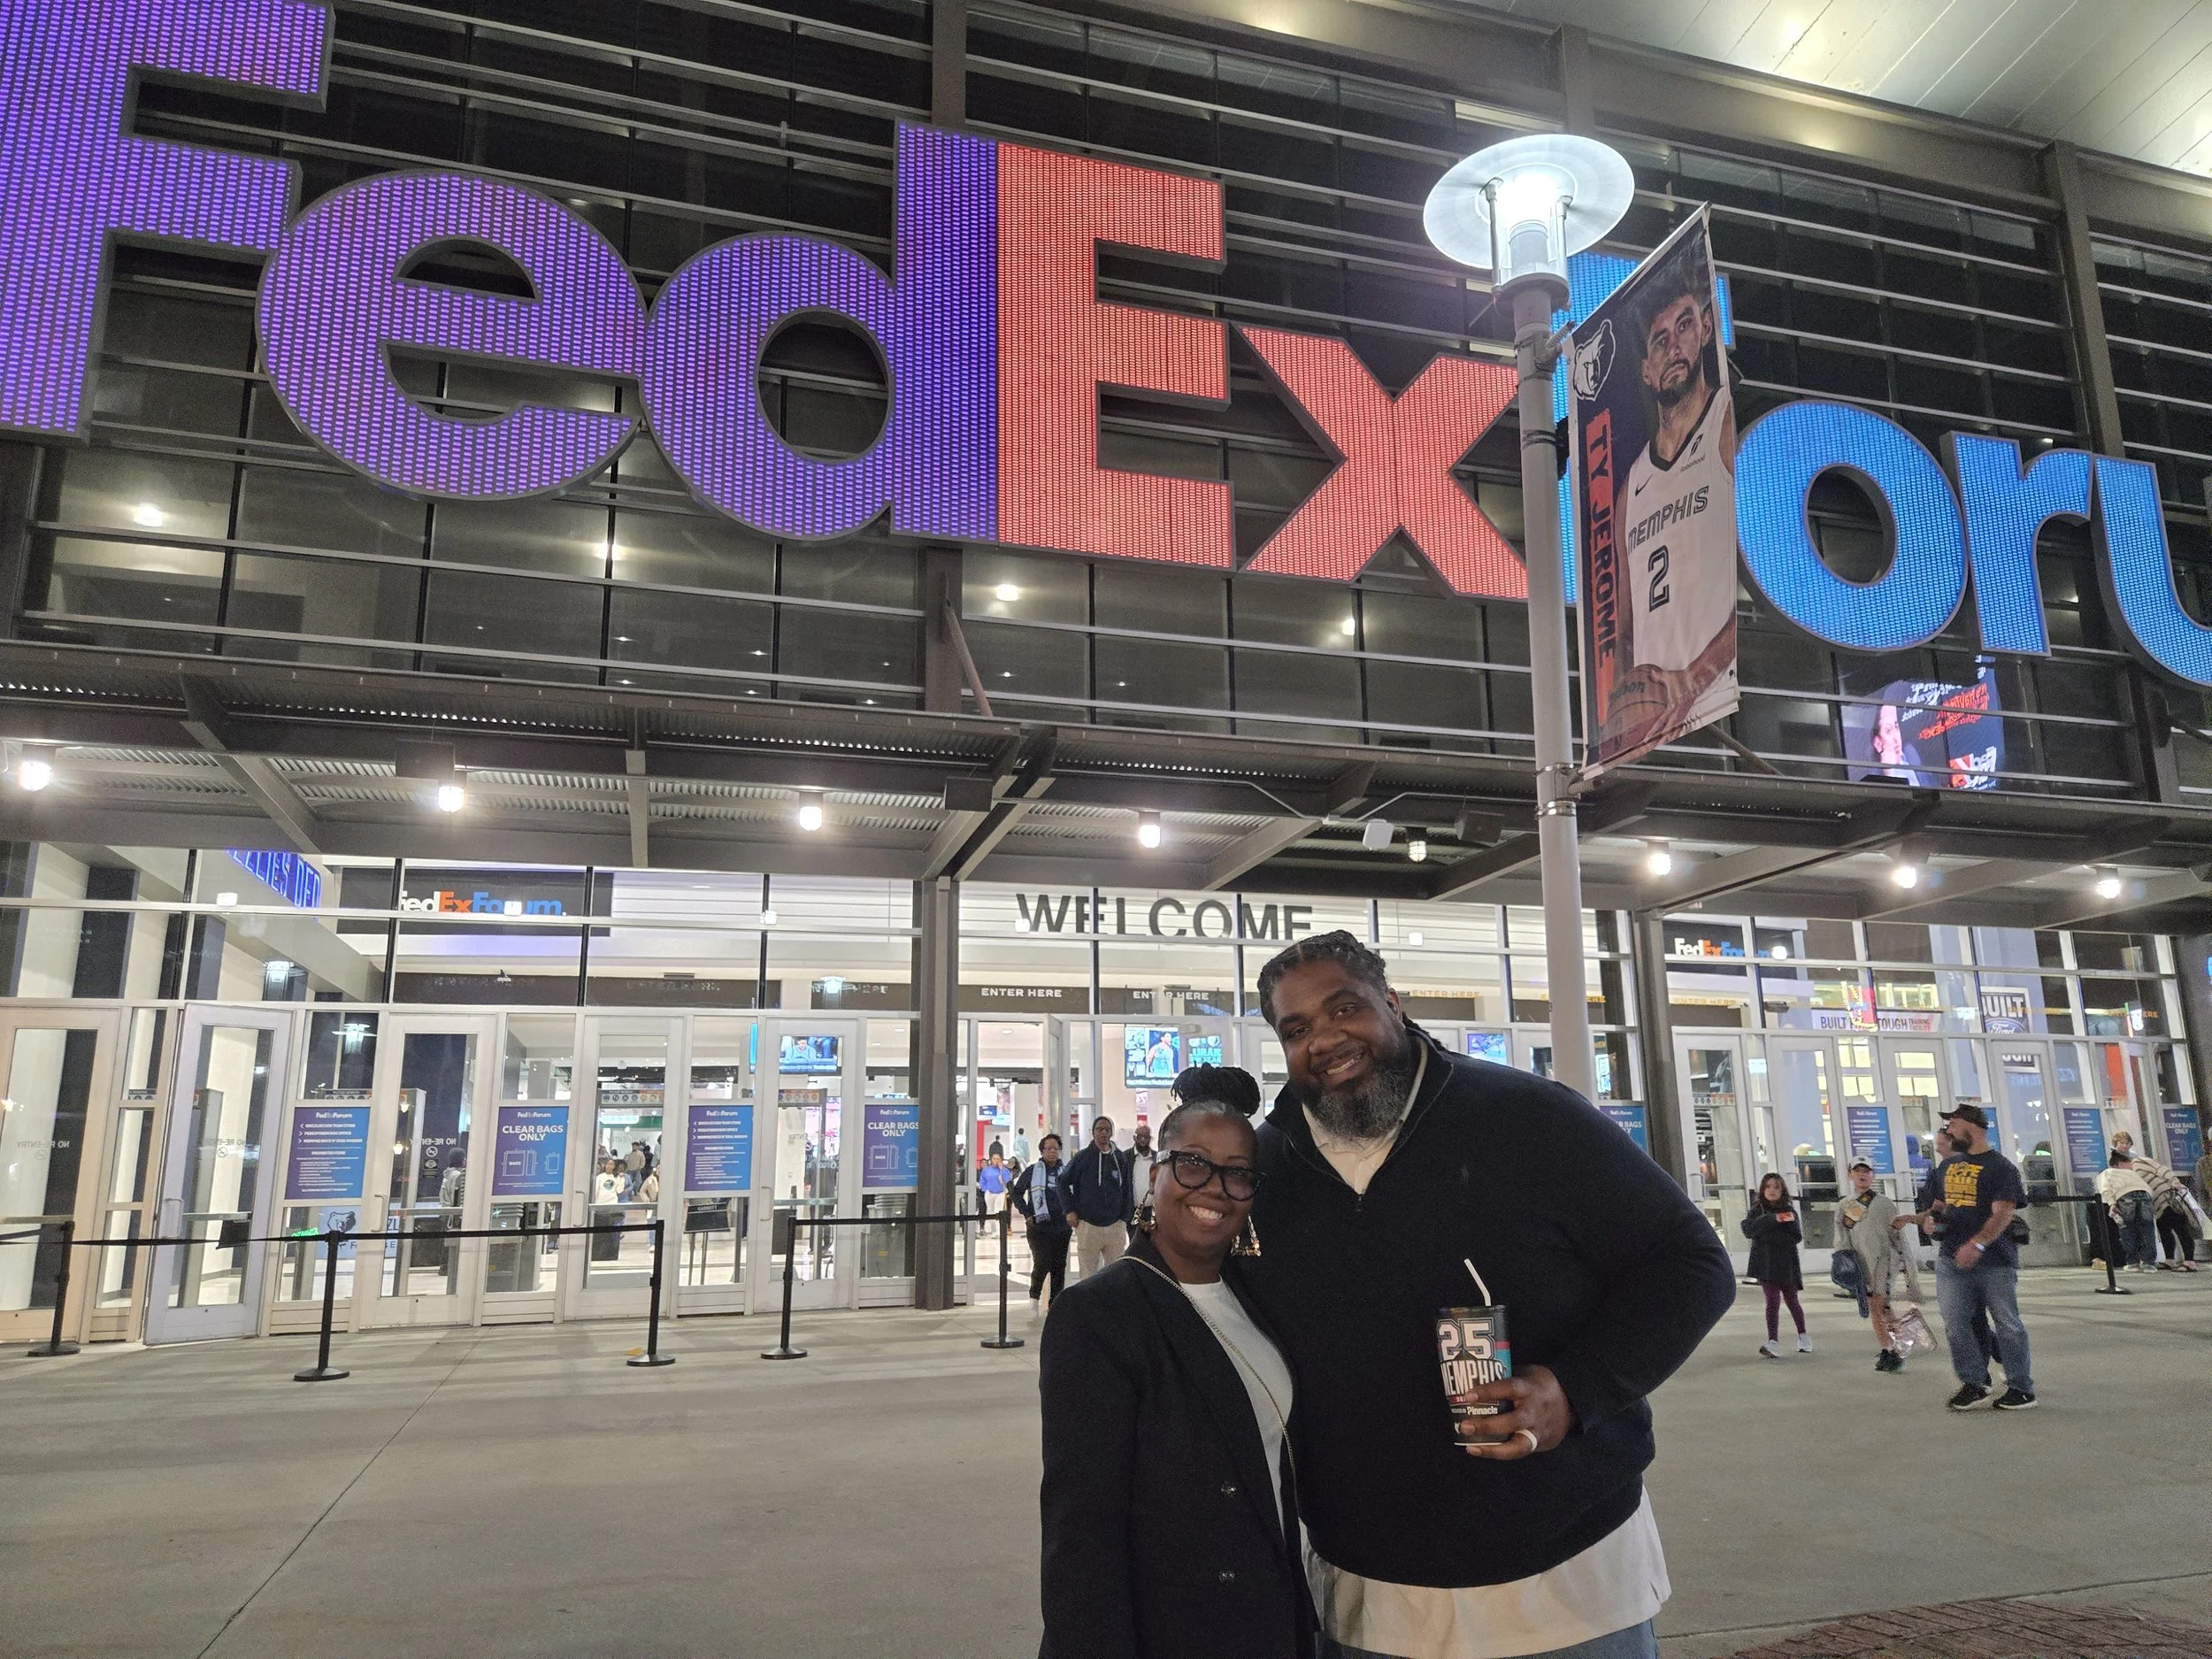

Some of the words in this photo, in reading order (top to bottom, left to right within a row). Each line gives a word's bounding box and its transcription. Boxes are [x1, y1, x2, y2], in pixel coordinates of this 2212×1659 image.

[1590, 425, 1609, 481] TY
[1628, 485, 1709, 556] MEMPHIS
[1592, 500, 1617, 669] JEROME
[1648, 545, 1670, 612] 2
[981, 988, 1025, 998] ENTER
[1027, 989, 1063, 998] HERE
[1133, 990, 1173, 1000] ENTR
[1177, 991, 1210, 1001] HERE
[1820, 1017, 1847, 1029] BUILT
[1437, 1317, 1495, 1361] 25
[1467, 1406, 1498, 1416] Pinnacle
